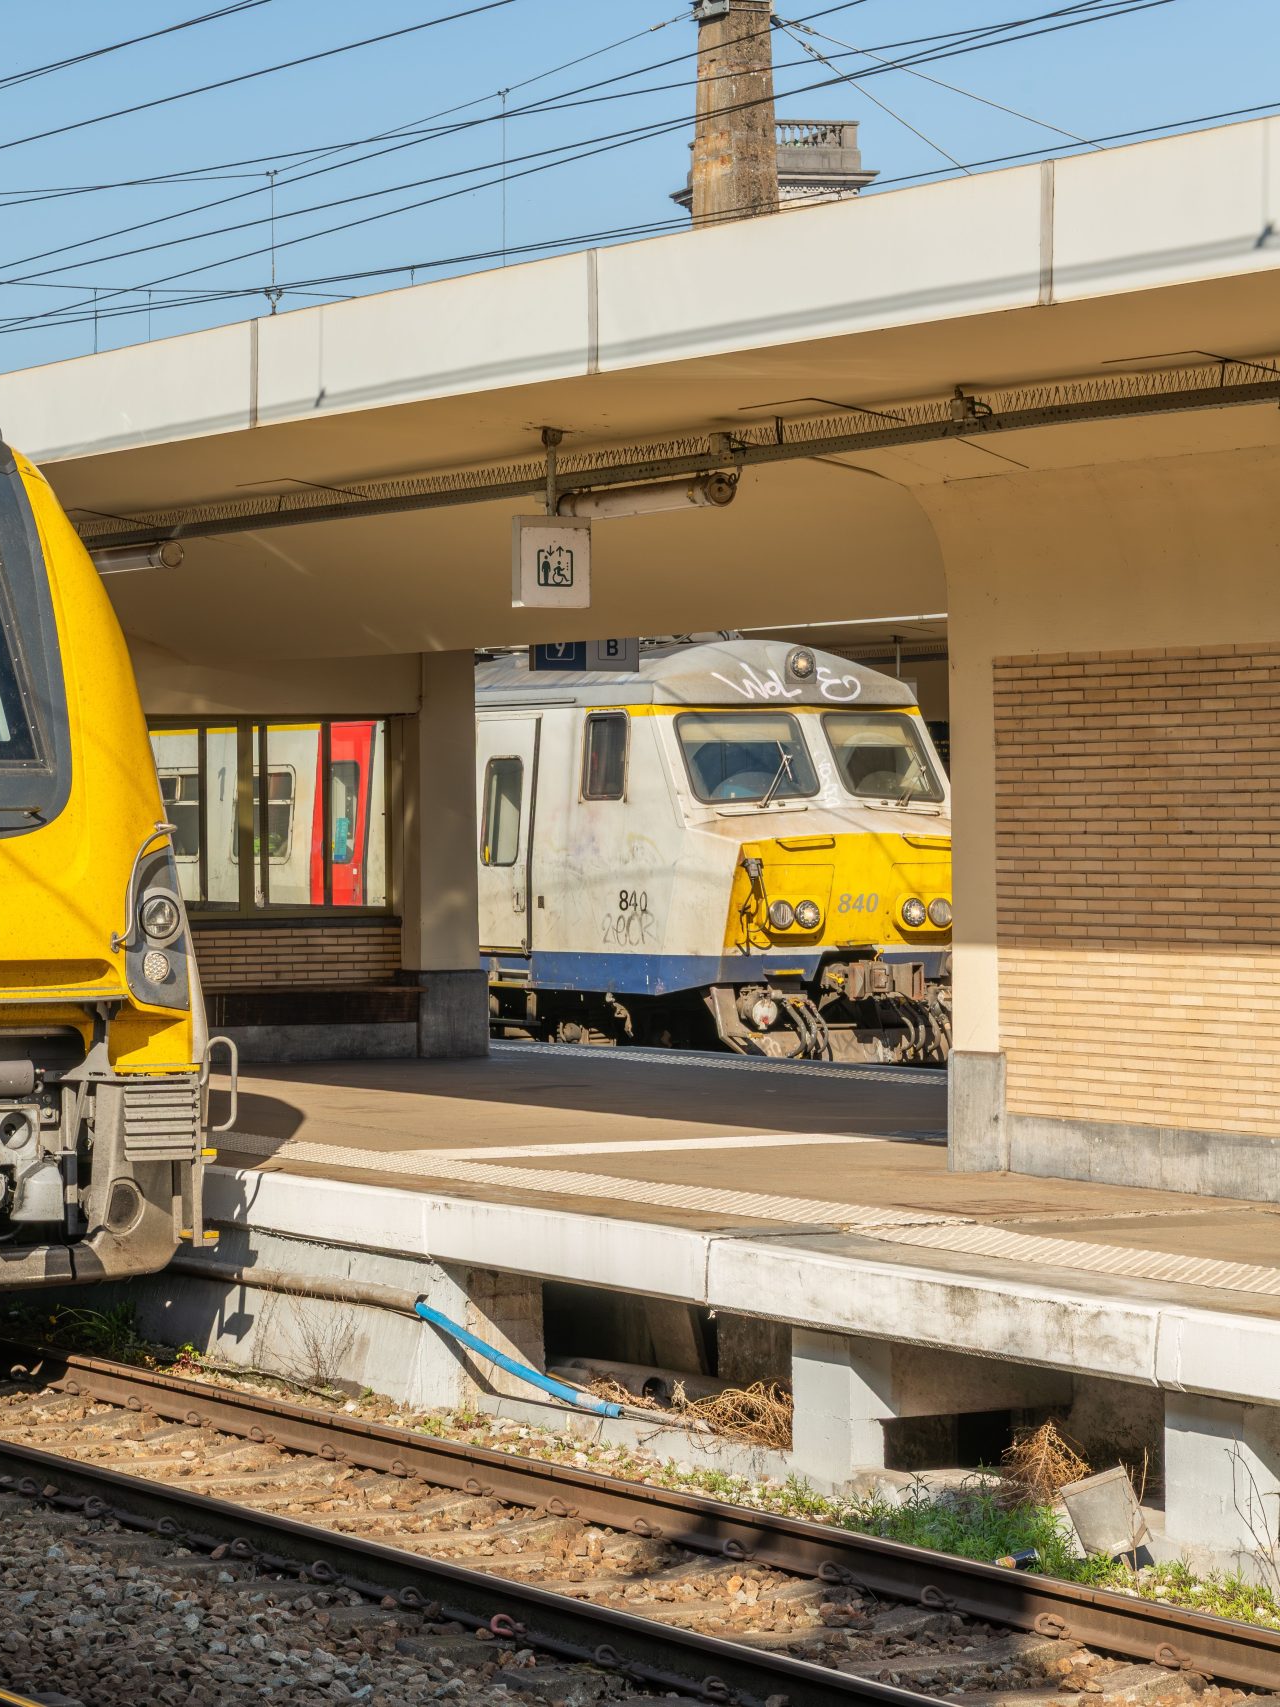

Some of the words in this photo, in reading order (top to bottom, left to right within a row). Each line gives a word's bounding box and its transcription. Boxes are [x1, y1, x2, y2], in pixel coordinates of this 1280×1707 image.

[606, 639, 618, 657] B
[619, 889, 648, 912] 840
[837, 893, 880, 913] 840
